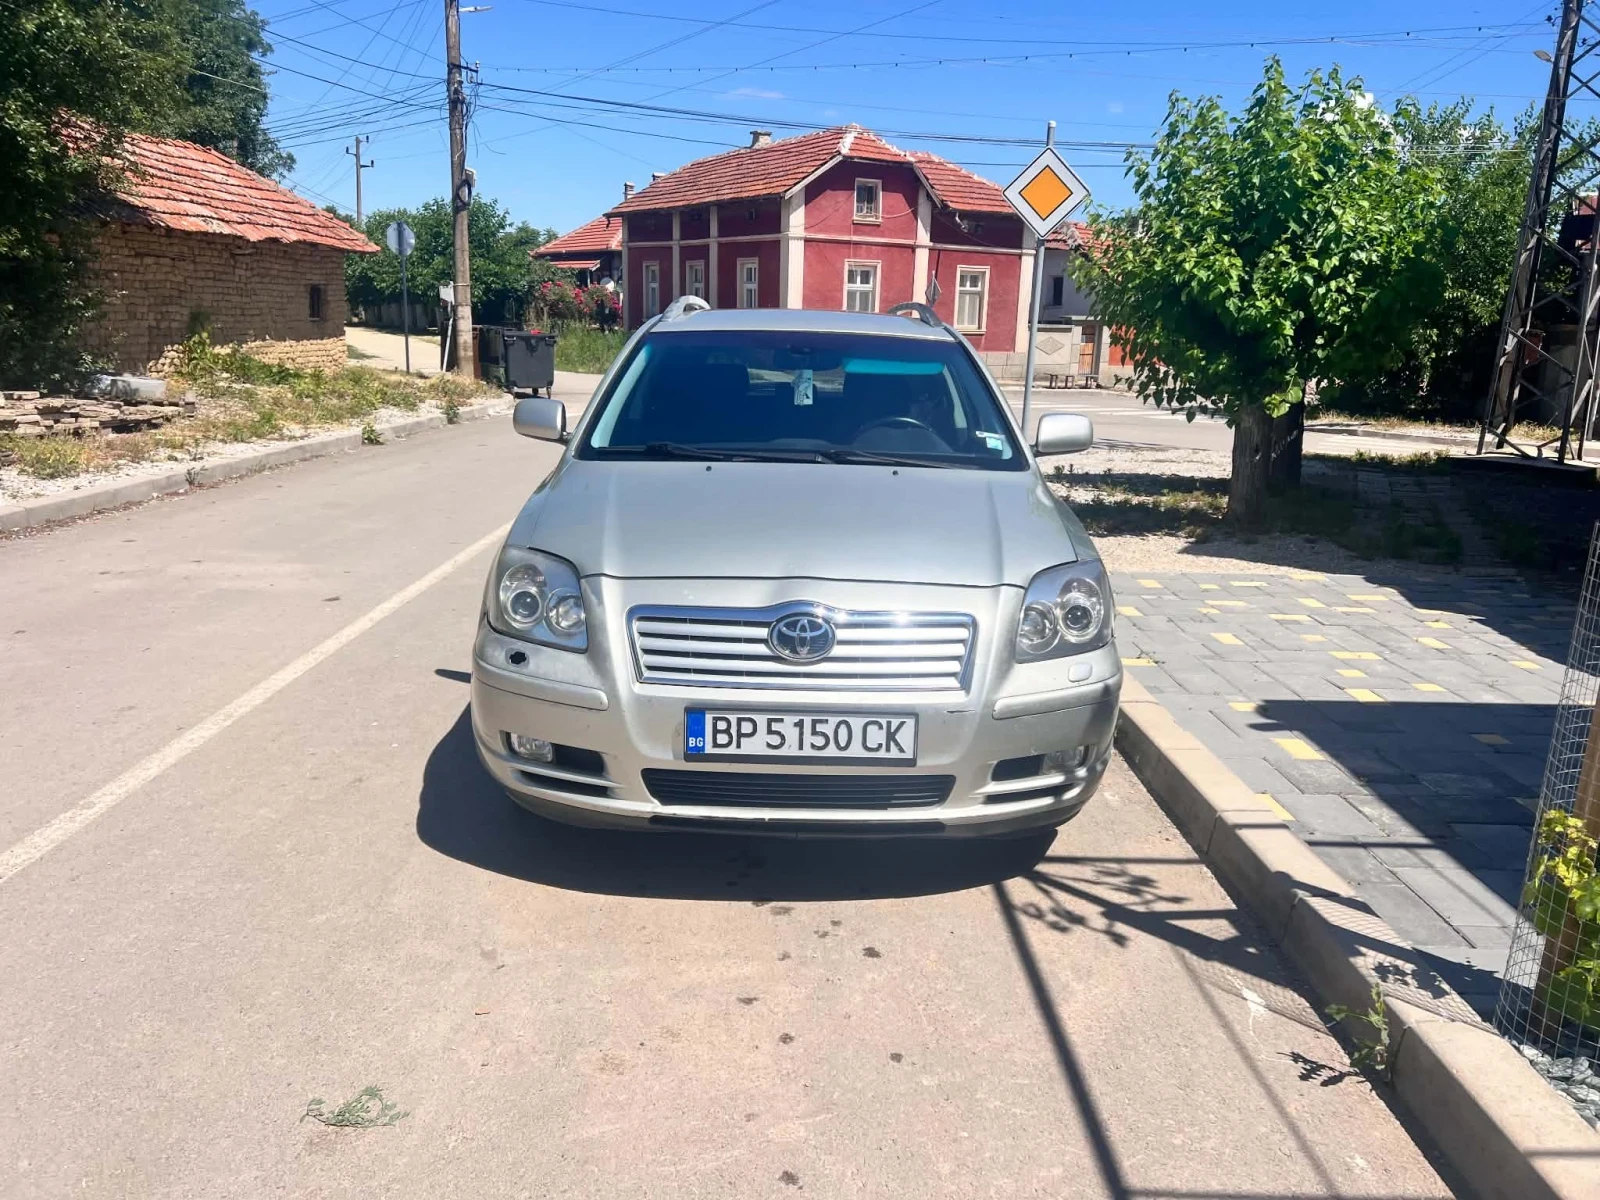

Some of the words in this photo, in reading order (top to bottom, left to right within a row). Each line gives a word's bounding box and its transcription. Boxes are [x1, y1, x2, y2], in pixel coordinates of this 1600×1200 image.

[688, 737, 704, 748] BG
[711, 716, 758, 750] BP
[765, 717, 853, 752] 5150
[861, 720, 907, 754] CK
